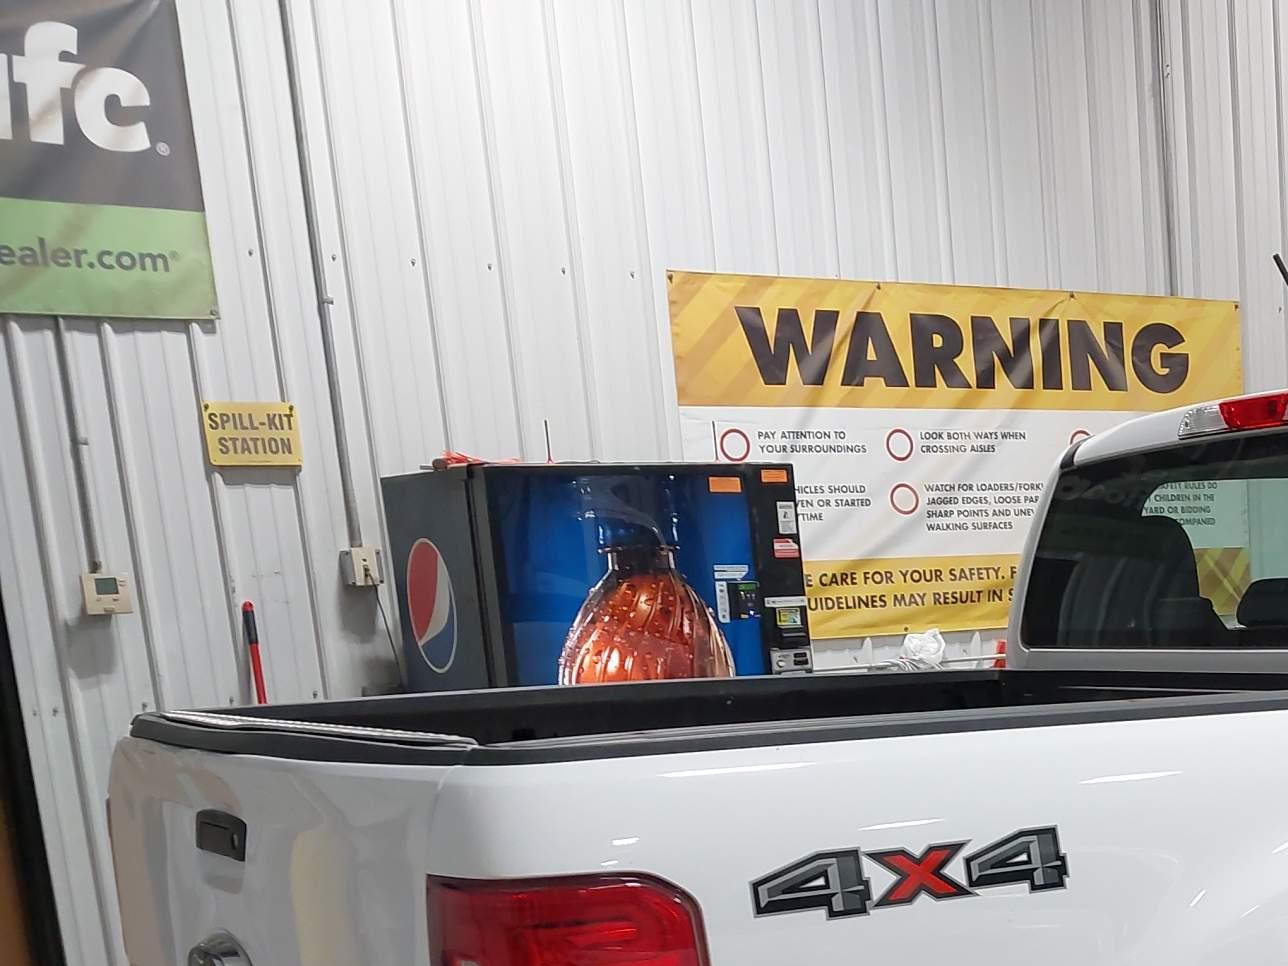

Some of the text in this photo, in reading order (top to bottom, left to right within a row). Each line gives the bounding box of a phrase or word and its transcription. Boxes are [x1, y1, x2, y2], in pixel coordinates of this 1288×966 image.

[734, 305, 1189, 394] WARNING
[208, 413, 293, 430] SPILL-KIT
[758, 431, 846, 440] PAY ATTENTION TO
[920, 432, 1026, 440] LOOK BOTH WAYS WHEN
[218, 437, 293, 455] STATION
[759, 445, 867, 453] YOUR SURROUNDINGS
[920, 445, 996, 453] CROSSING AISLES
[828, 485, 866, 494] SHOULD
[924, 484, 955, 492] WATCH
[957, 483, 974, 492] FOR
[926, 497, 959, 505] JAGGED
[961, 496, 992, 505] EDGES,
[994, 496, 1021, 504] LOOSE
[1154, 494, 1191, 502] CHILDREN
[817, 500, 832, 508] OR
[834, 499, 871, 507] STARTED
[926, 510, 954, 518] SHARP
[957, 509, 989, 517] POINTS
[992, 508, 1012, 516] AND
[926, 522, 1013, 531] WALKING SURFACES
[819, 572, 857, 587] CARE
[864, 570, 894, 586] FOR
[900, 568, 944, 584] YOUR
[949, 566, 1005, 582] SAFETY.
[893, 592, 926, 608] MAY
[932, 589, 983, 605] RESULT
[987, 588, 1004, 602] IN
